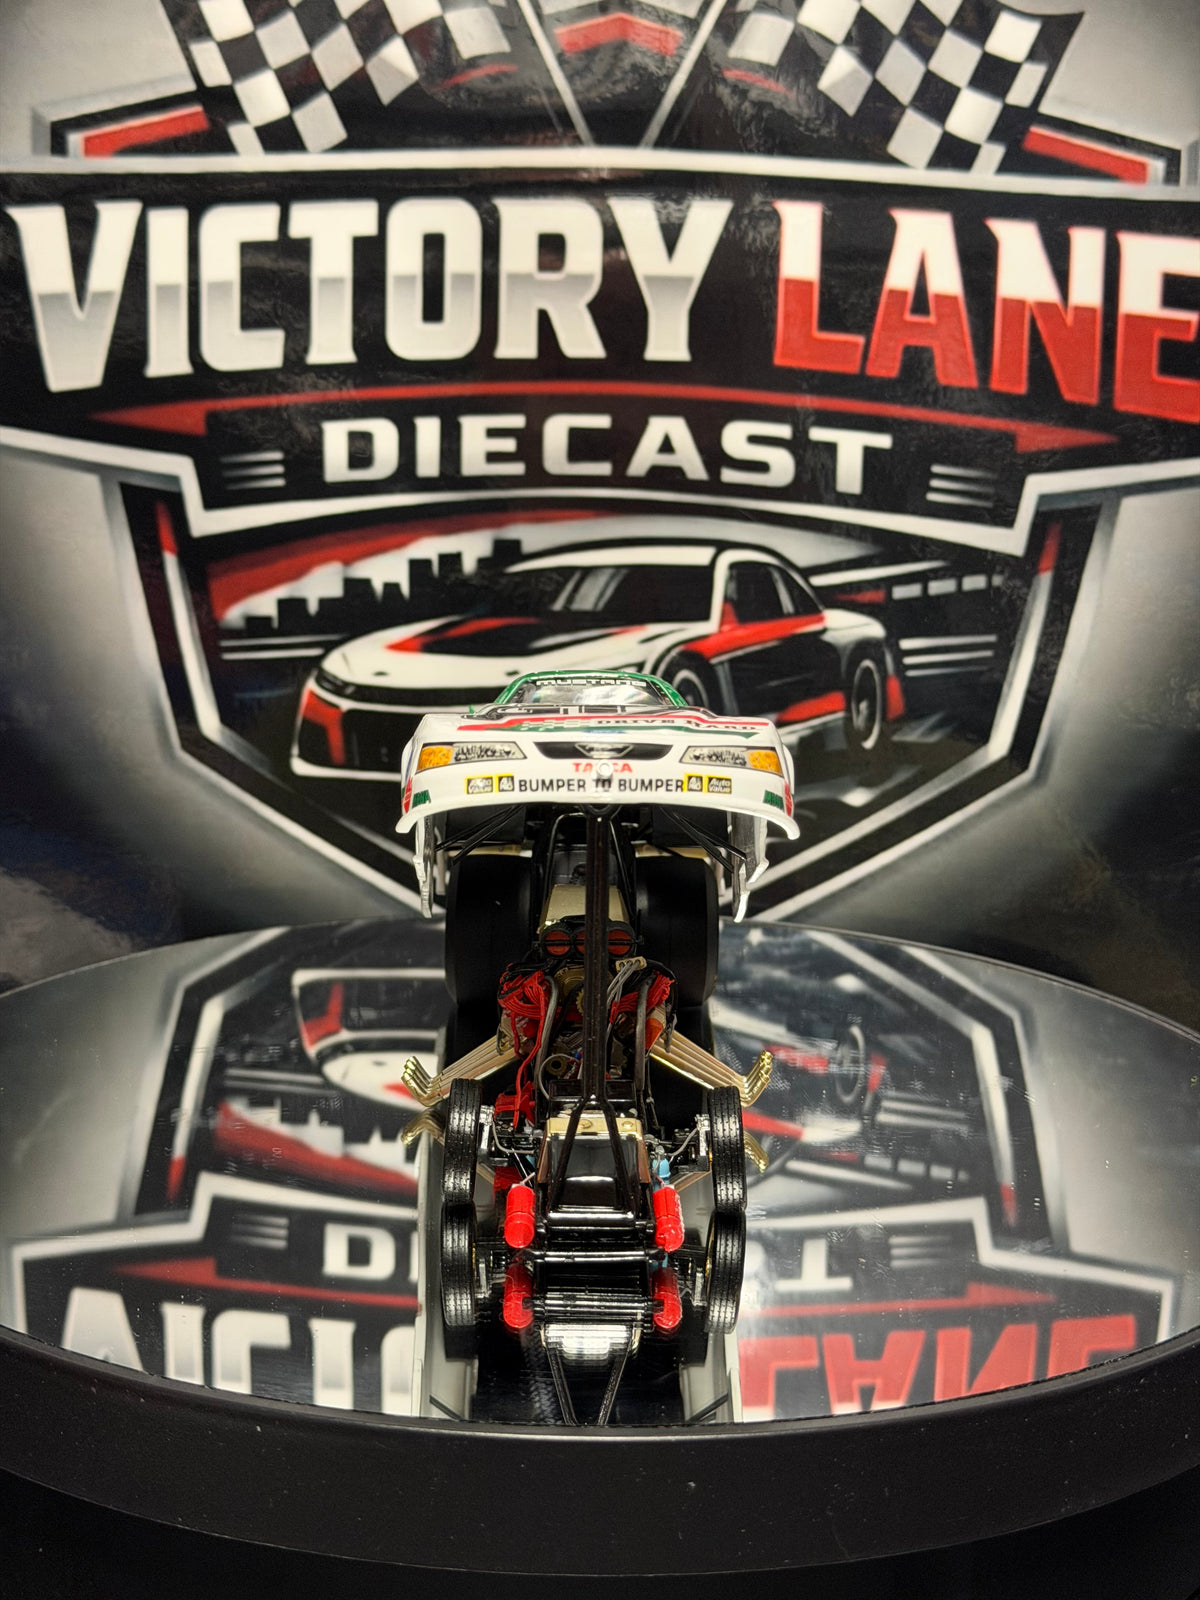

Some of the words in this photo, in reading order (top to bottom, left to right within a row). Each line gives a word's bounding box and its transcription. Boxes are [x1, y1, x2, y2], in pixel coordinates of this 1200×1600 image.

[5, 196, 733, 393] VICTORY
[773, 199, 1200, 424] LANE
[321, 413, 893, 495] DIECAST
[535, 678, 647, 687] MUSTANG
[684, 719, 757, 730] HARD
[572, 762, 633, 773] TACA
[518, 778, 586, 792] BUMPER
[592, 778, 612, 792] TO
[618, 778, 684, 792] BUMPER
